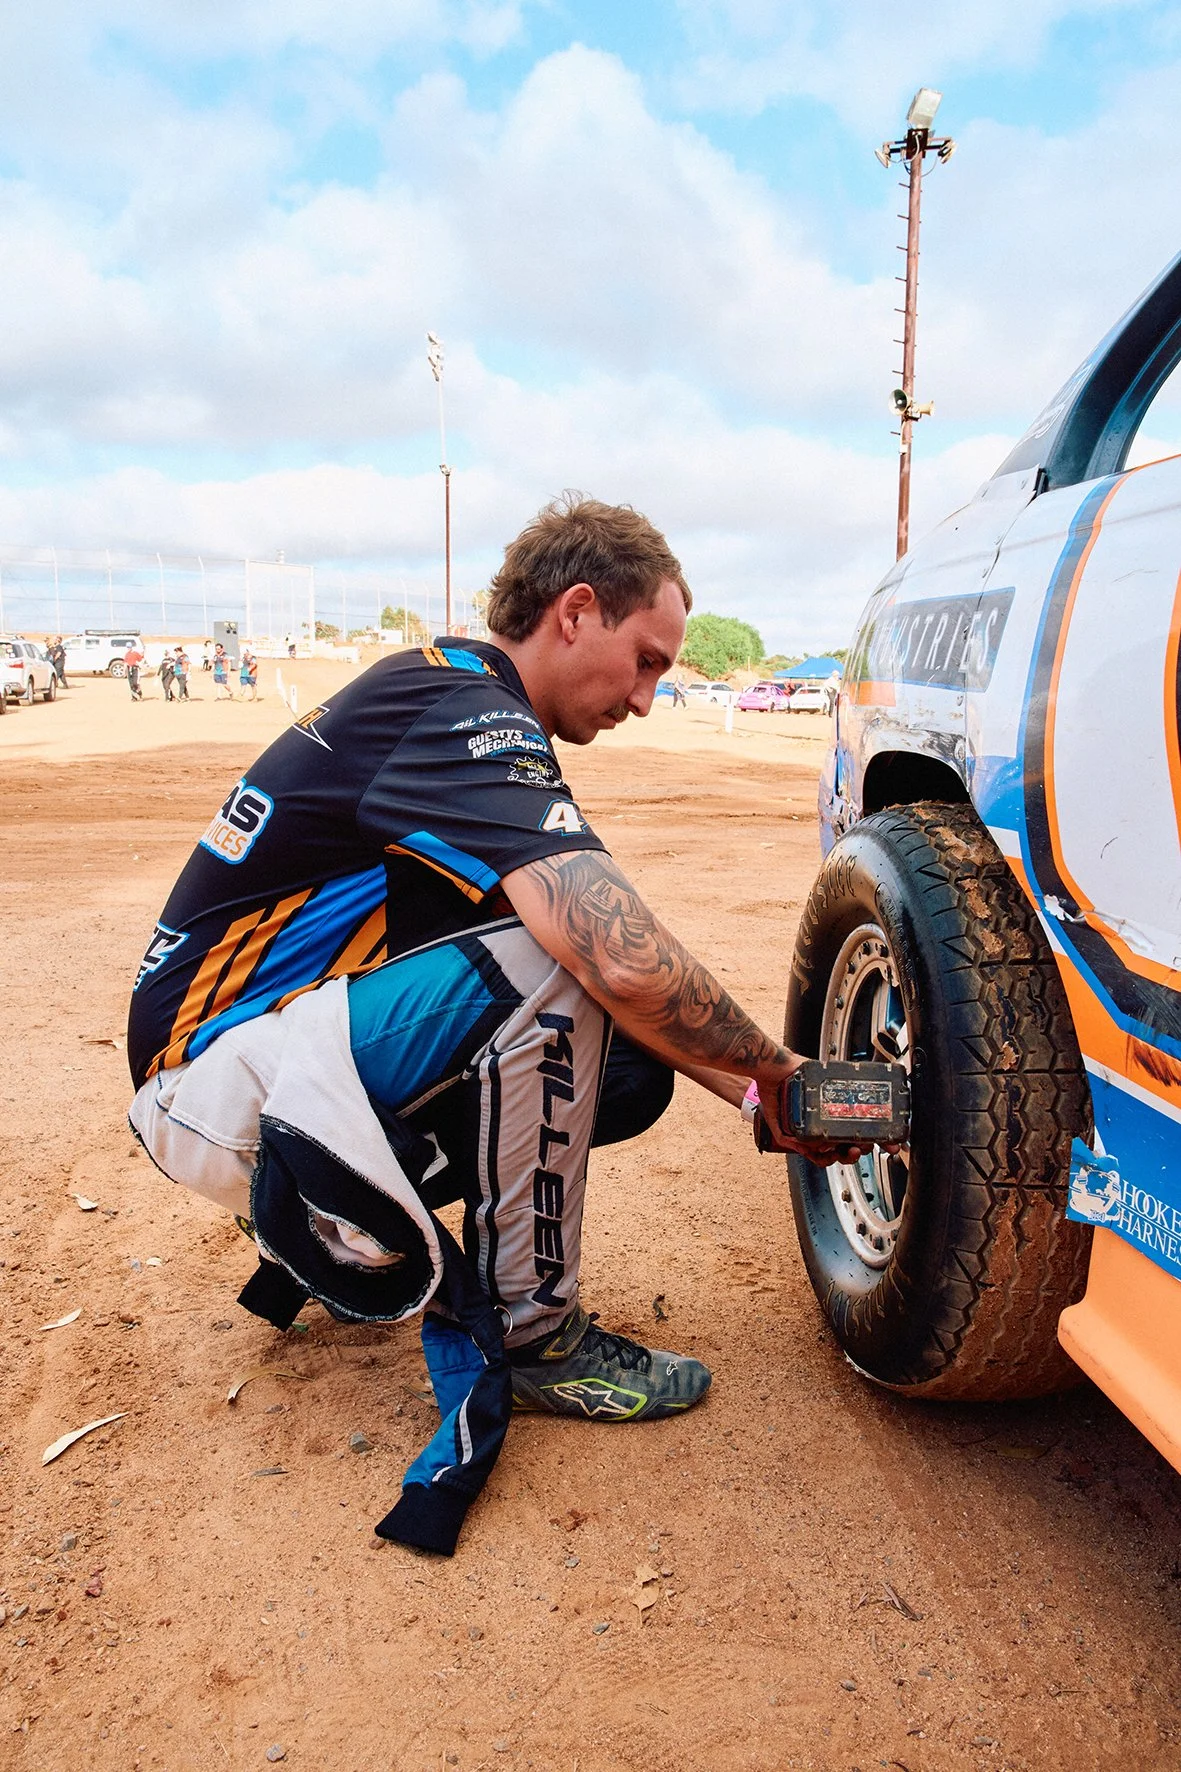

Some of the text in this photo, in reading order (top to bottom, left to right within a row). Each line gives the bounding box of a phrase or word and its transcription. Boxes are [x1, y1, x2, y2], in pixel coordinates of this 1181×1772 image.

[467, 729, 524, 750] GUESTYS
[541, 801, 587, 835] 4
[531, 1012, 574, 1307] KILLEEN
